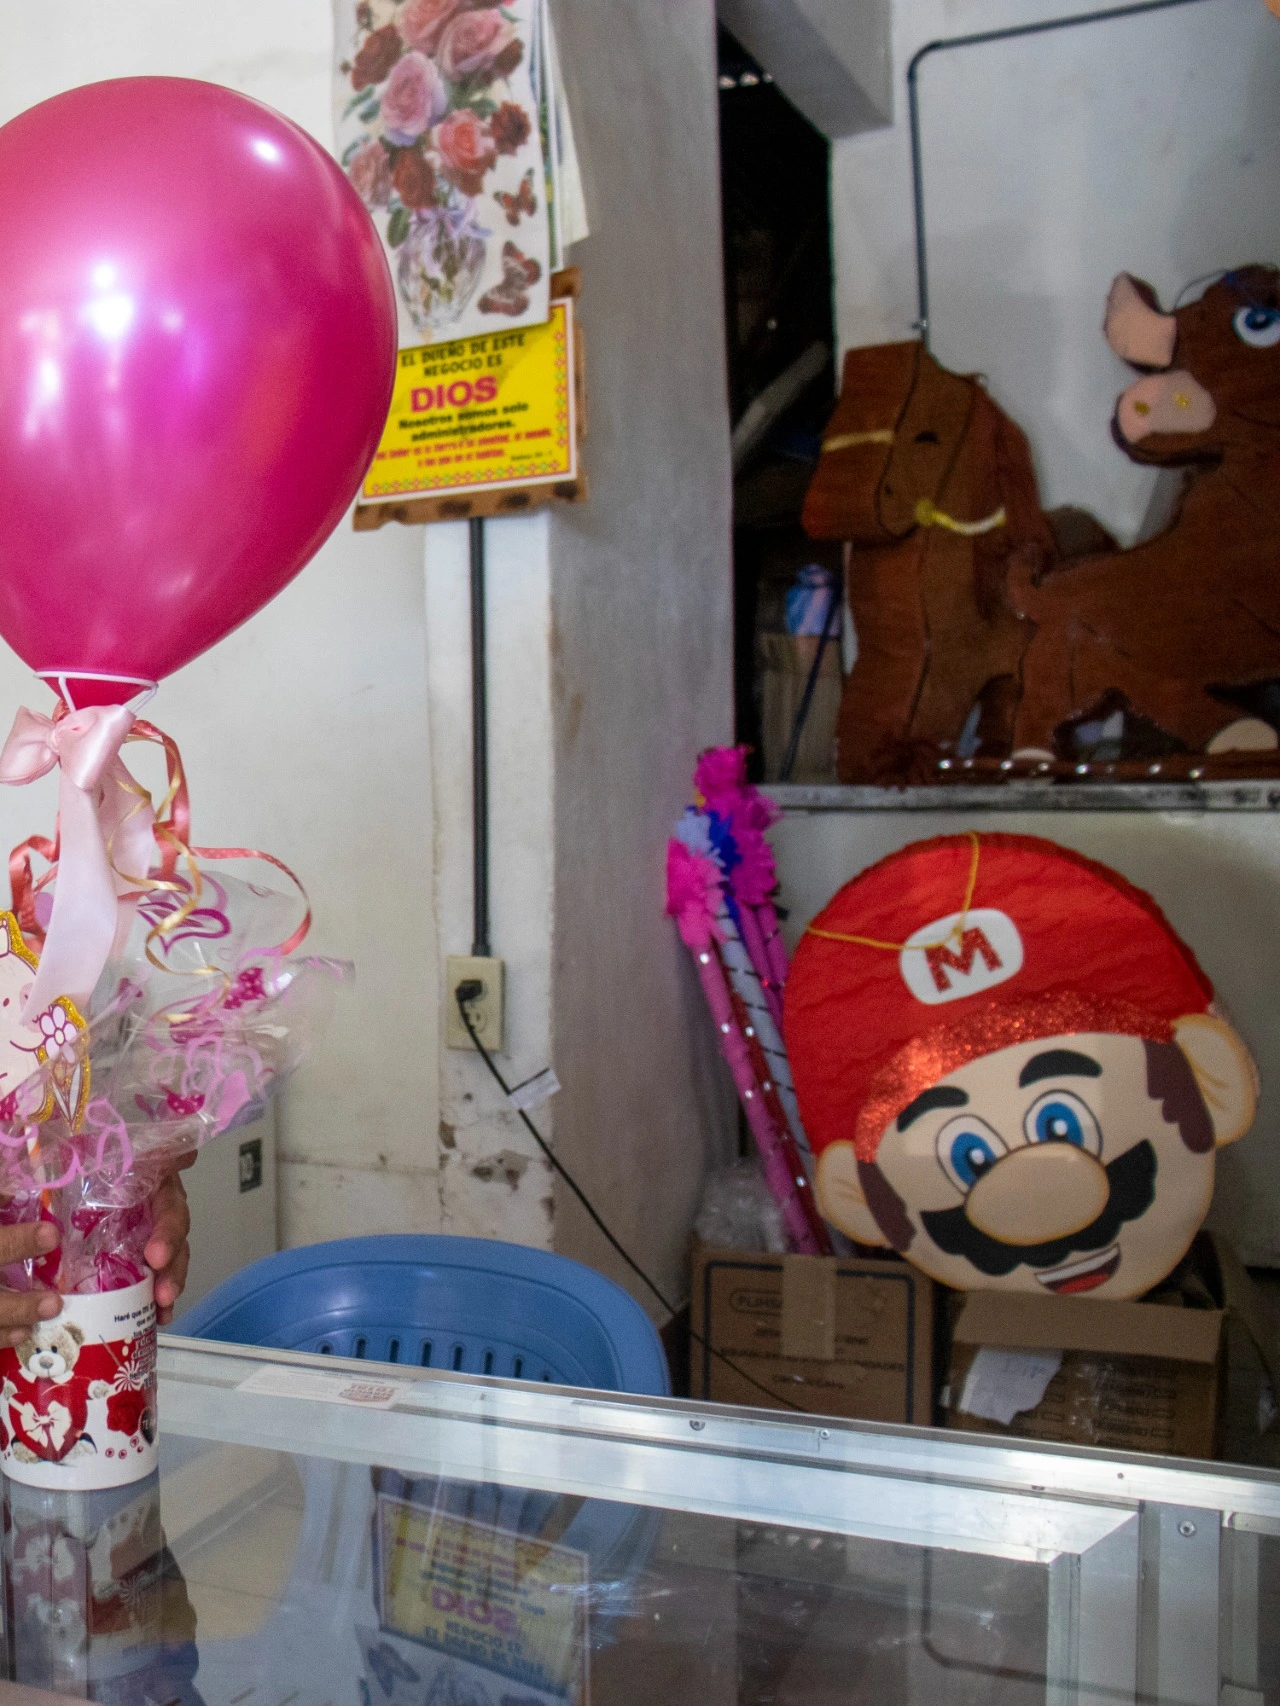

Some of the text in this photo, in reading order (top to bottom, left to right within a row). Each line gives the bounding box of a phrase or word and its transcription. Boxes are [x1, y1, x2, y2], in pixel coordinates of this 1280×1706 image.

[401, 352, 416, 367] EL
[470, 339, 487, 355] DE
[493, 333, 525, 351] ESTE
[424, 354, 503, 377] NEGOCIO ES
[410, 375, 499, 413] DIOS
[399, 402, 529, 429] Nosotros somos solo
[924, 926, 1004, 994] M
